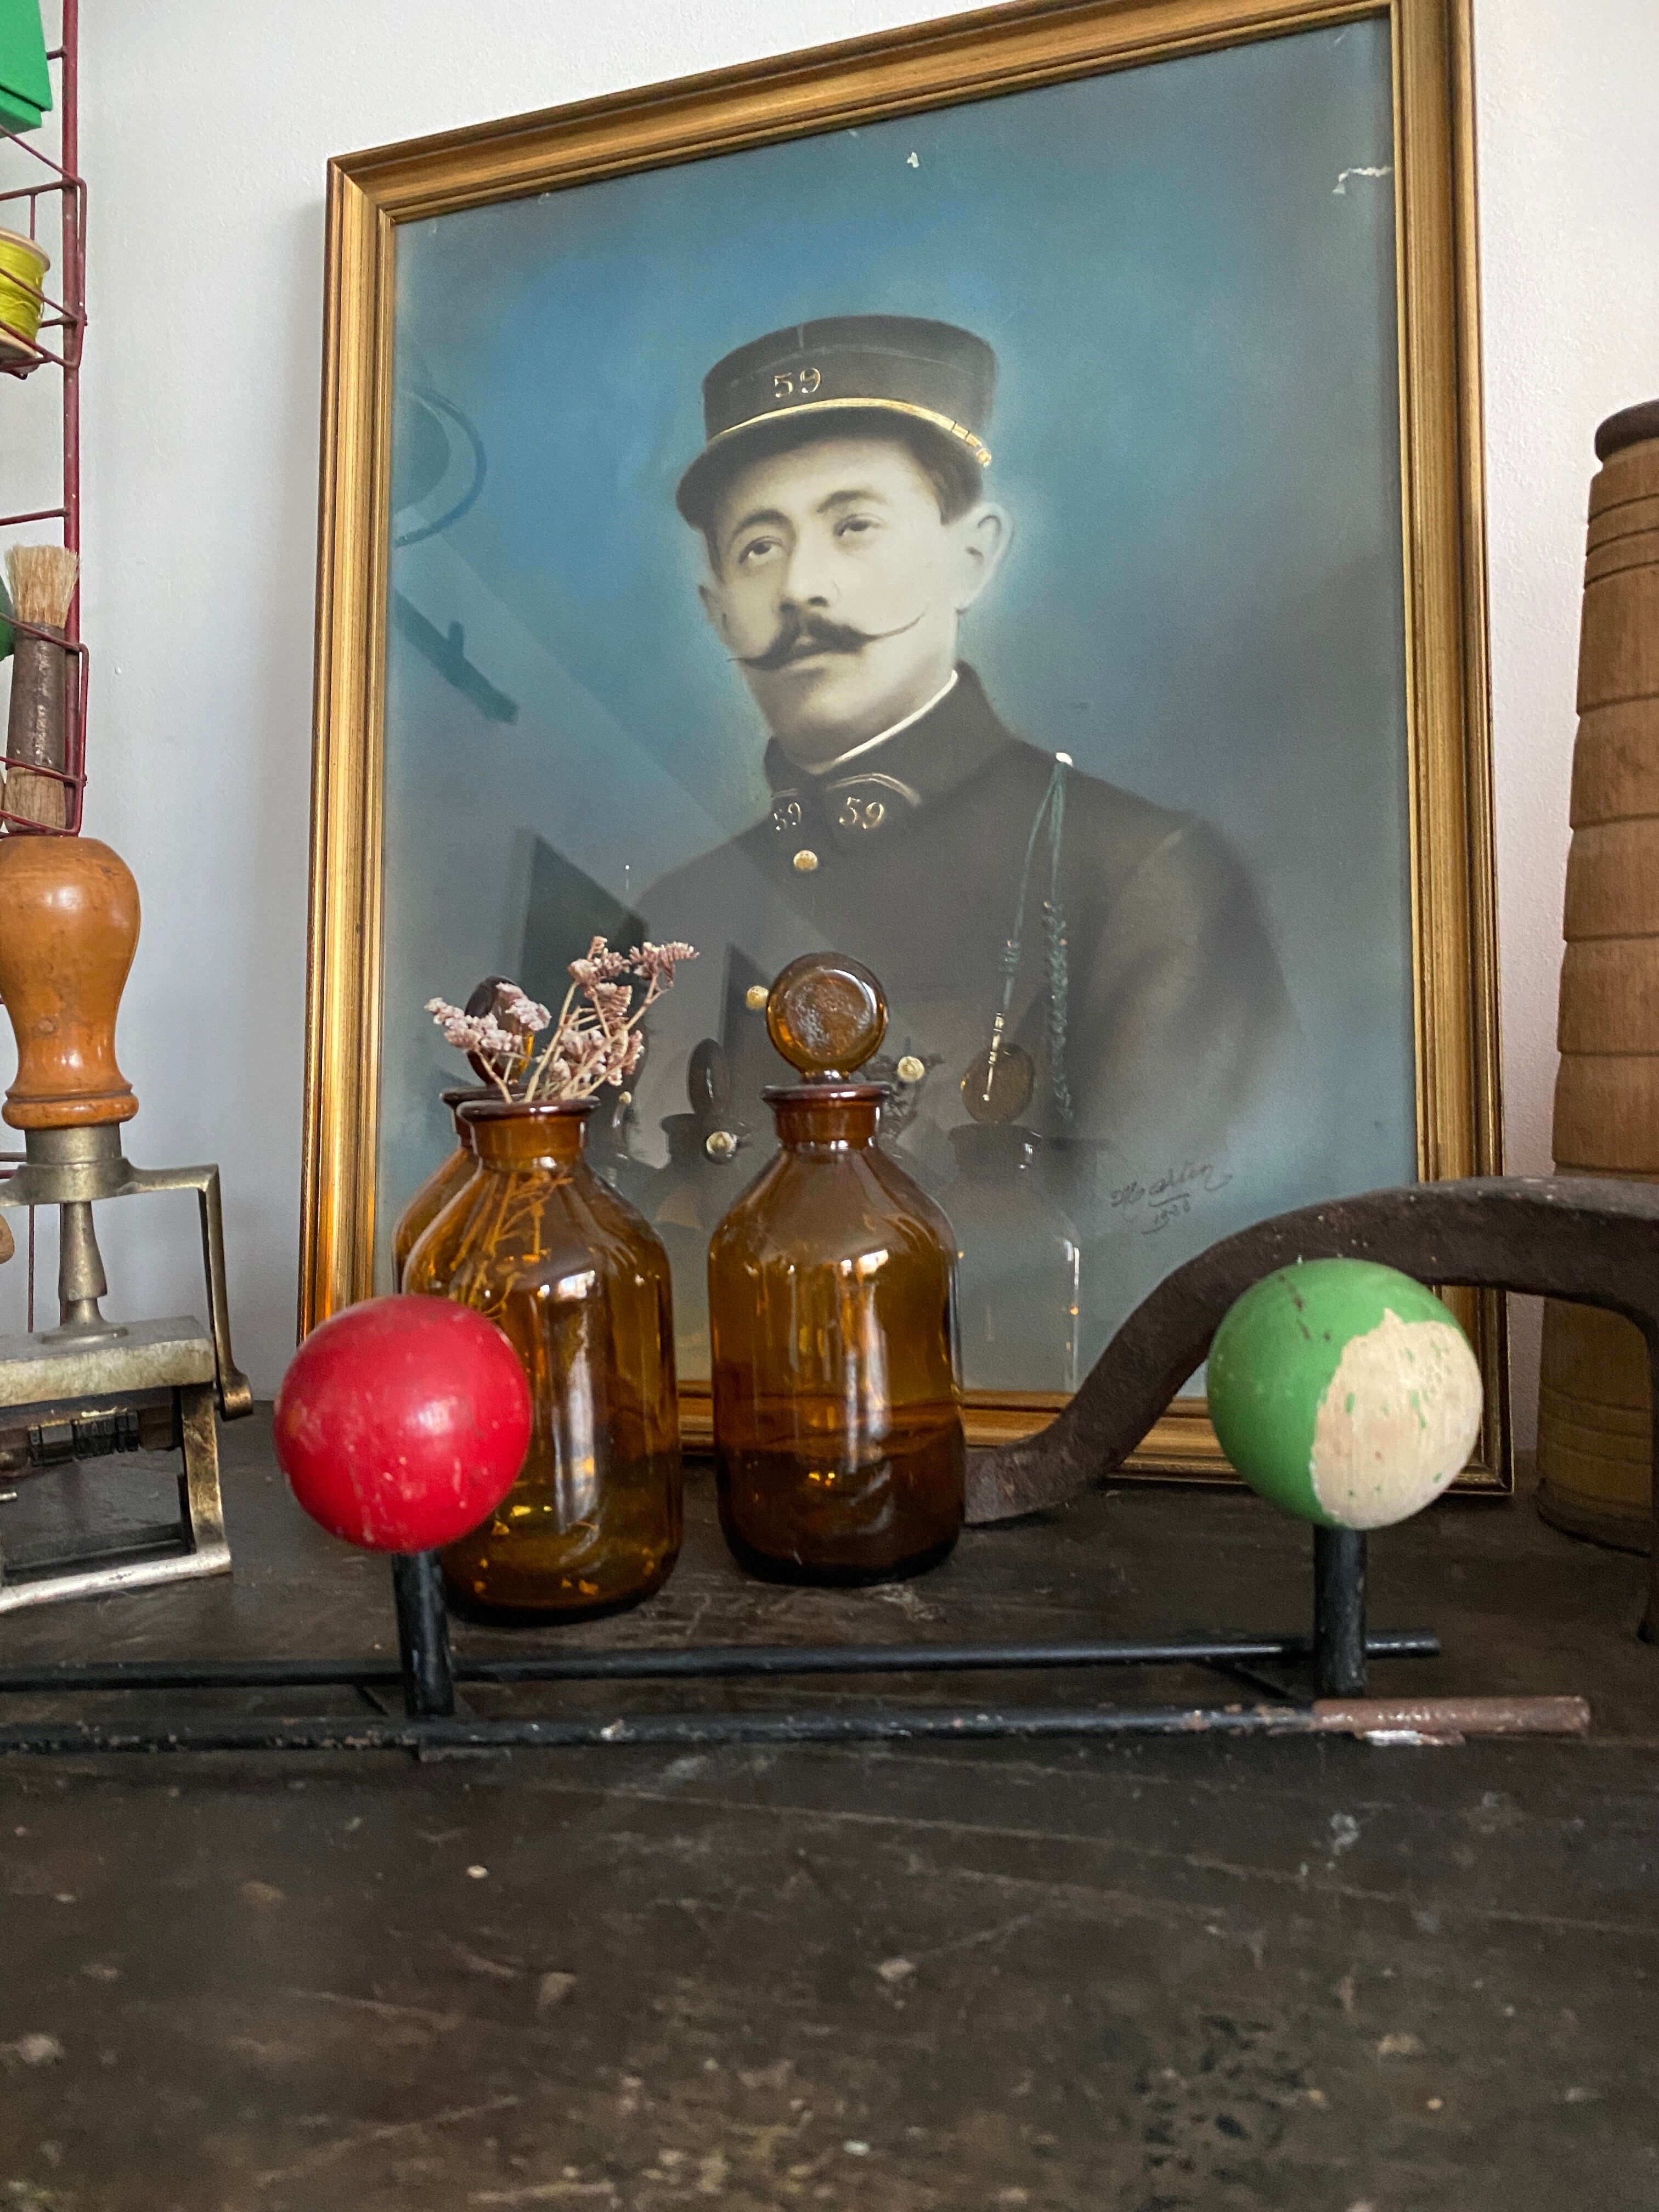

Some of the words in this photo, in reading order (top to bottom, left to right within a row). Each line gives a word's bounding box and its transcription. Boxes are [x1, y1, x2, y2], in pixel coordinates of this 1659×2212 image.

[774, 367, 821, 398] 59
[772, 802, 803, 831] 59
[838, 797, 885, 830] 59
